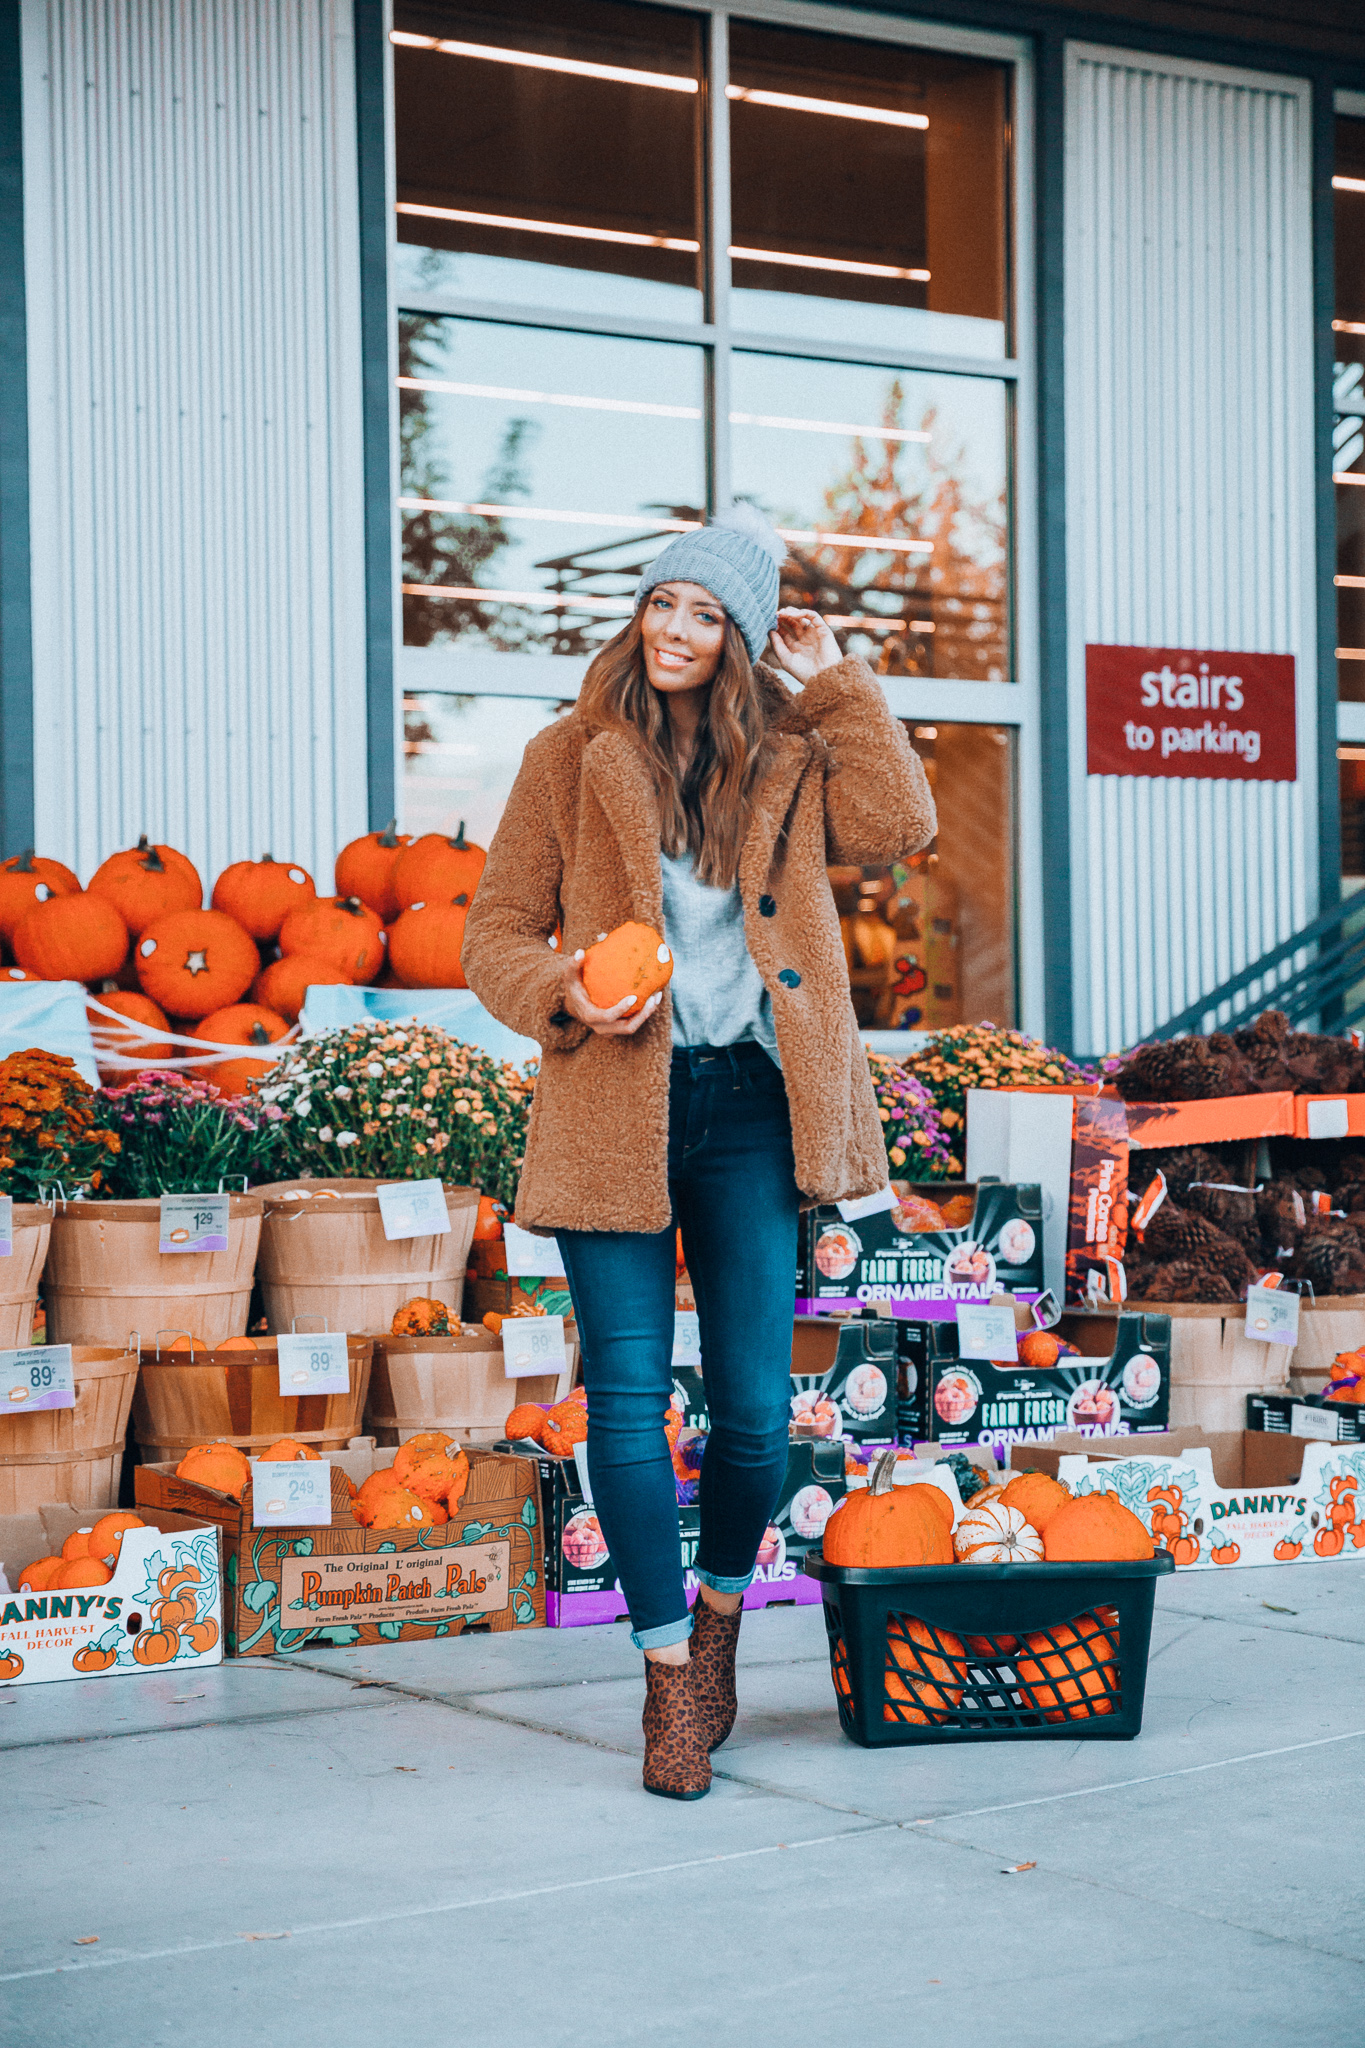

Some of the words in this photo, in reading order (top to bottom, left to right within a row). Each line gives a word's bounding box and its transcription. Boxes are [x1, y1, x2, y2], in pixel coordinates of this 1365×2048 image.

[1141, 662, 1244, 711] stairs
[1123, 720, 1155, 750] to
[1161, 720, 1261, 763] parking
[860, 1258, 898, 1283] FARM
[902, 1258, 942, 1282] FRESH
[856, 1281, 1005, 1302] ORNAMENTALS
[981, 1401, 1020, 1428] FARM
[1024, 1399, 1065, 1425] FRESH
[1210, 1494, 1307, 1521] DANNY'S
[1244, 1530, 1275, 1539] DECOR
[1250, 1519, 1290, 1529] HARVEST
[324, 1563, 343, 1573] The
[347, 1561, 389, 1573] Original
[395, 1559, 404, 1569] L'
[406, 1556, 443, 1569] original
[301, 1571, 383, 1610] Pumpkin
[385, 1573, 431, 1602] Patch
[0, 1595, 124, 1626] ANNY'S
[1, 1630, 30, 1640] FALL
[36, 1624, 96, 1638] HARVEST
[27, 1638, 73, 1650] DECOR
